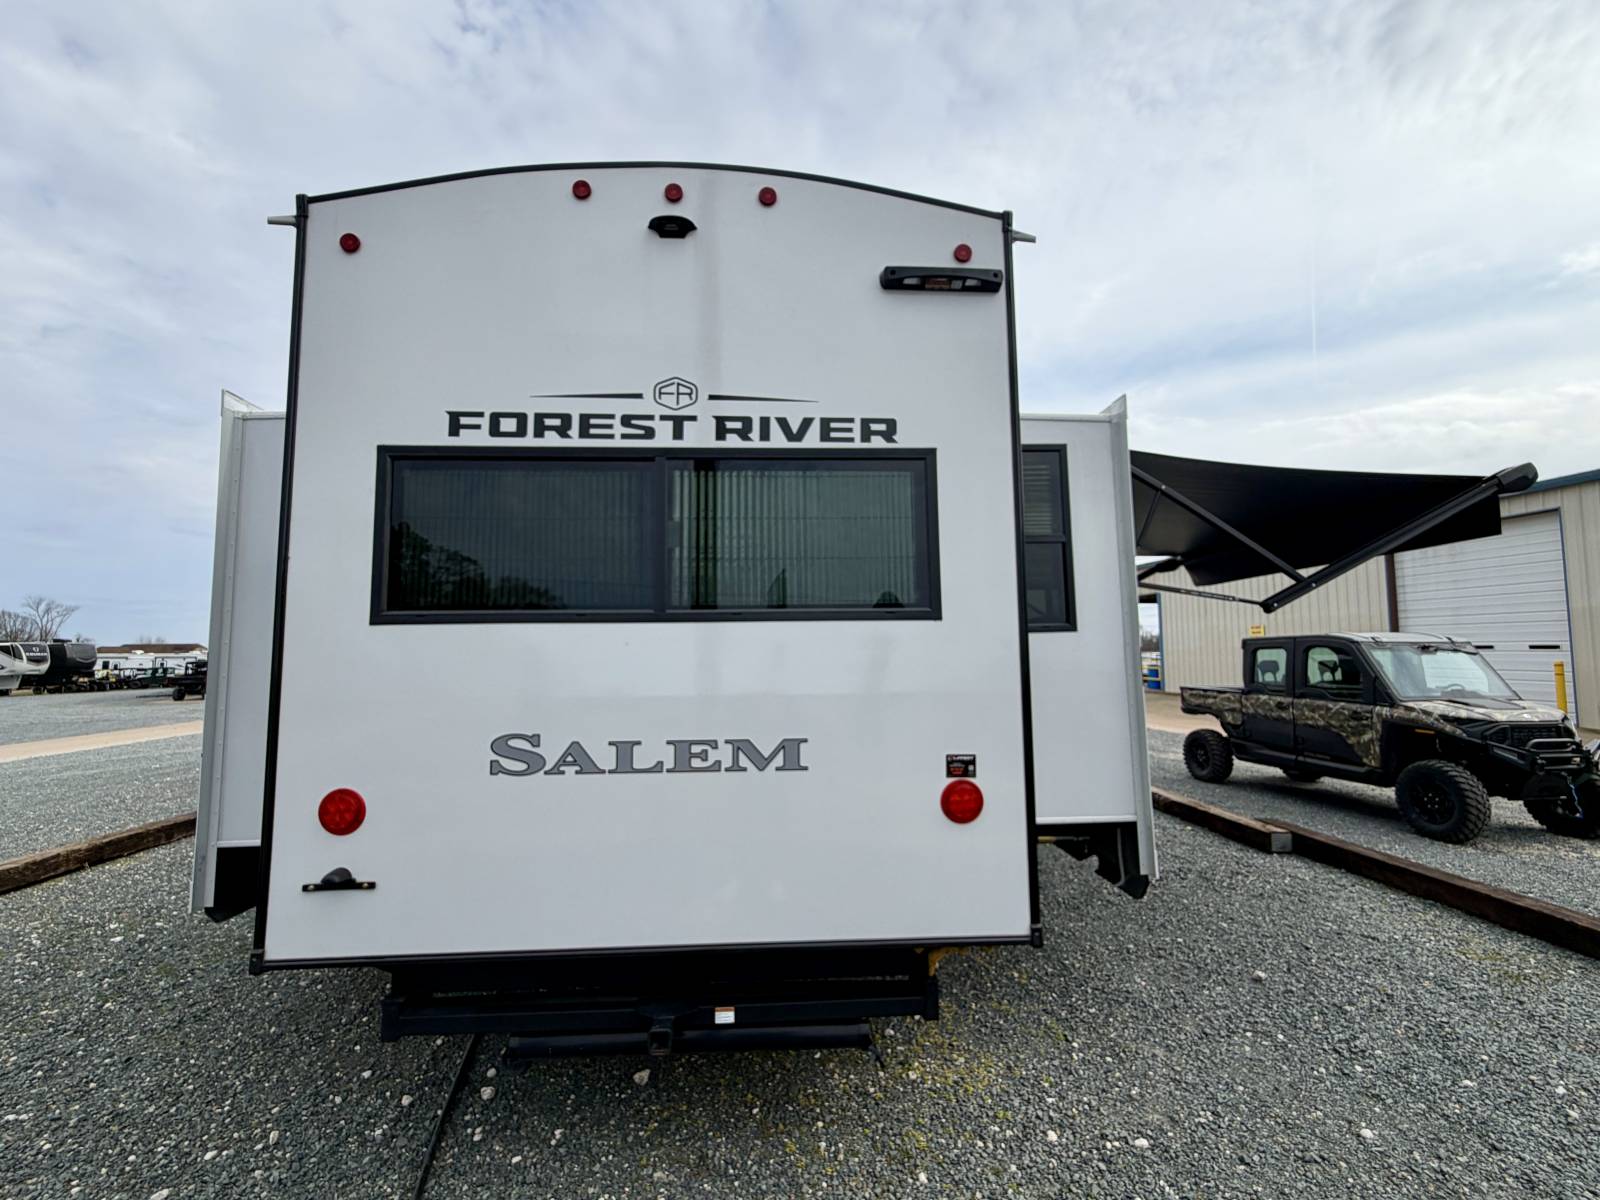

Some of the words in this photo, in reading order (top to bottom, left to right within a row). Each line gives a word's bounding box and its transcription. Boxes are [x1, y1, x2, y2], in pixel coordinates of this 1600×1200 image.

[658, 381, 694, 406] FR
[445, 410, 698, 441] FOREST
[711, 415, 899, 444] RIVER
[489, 733, 809, 777] SALEM
